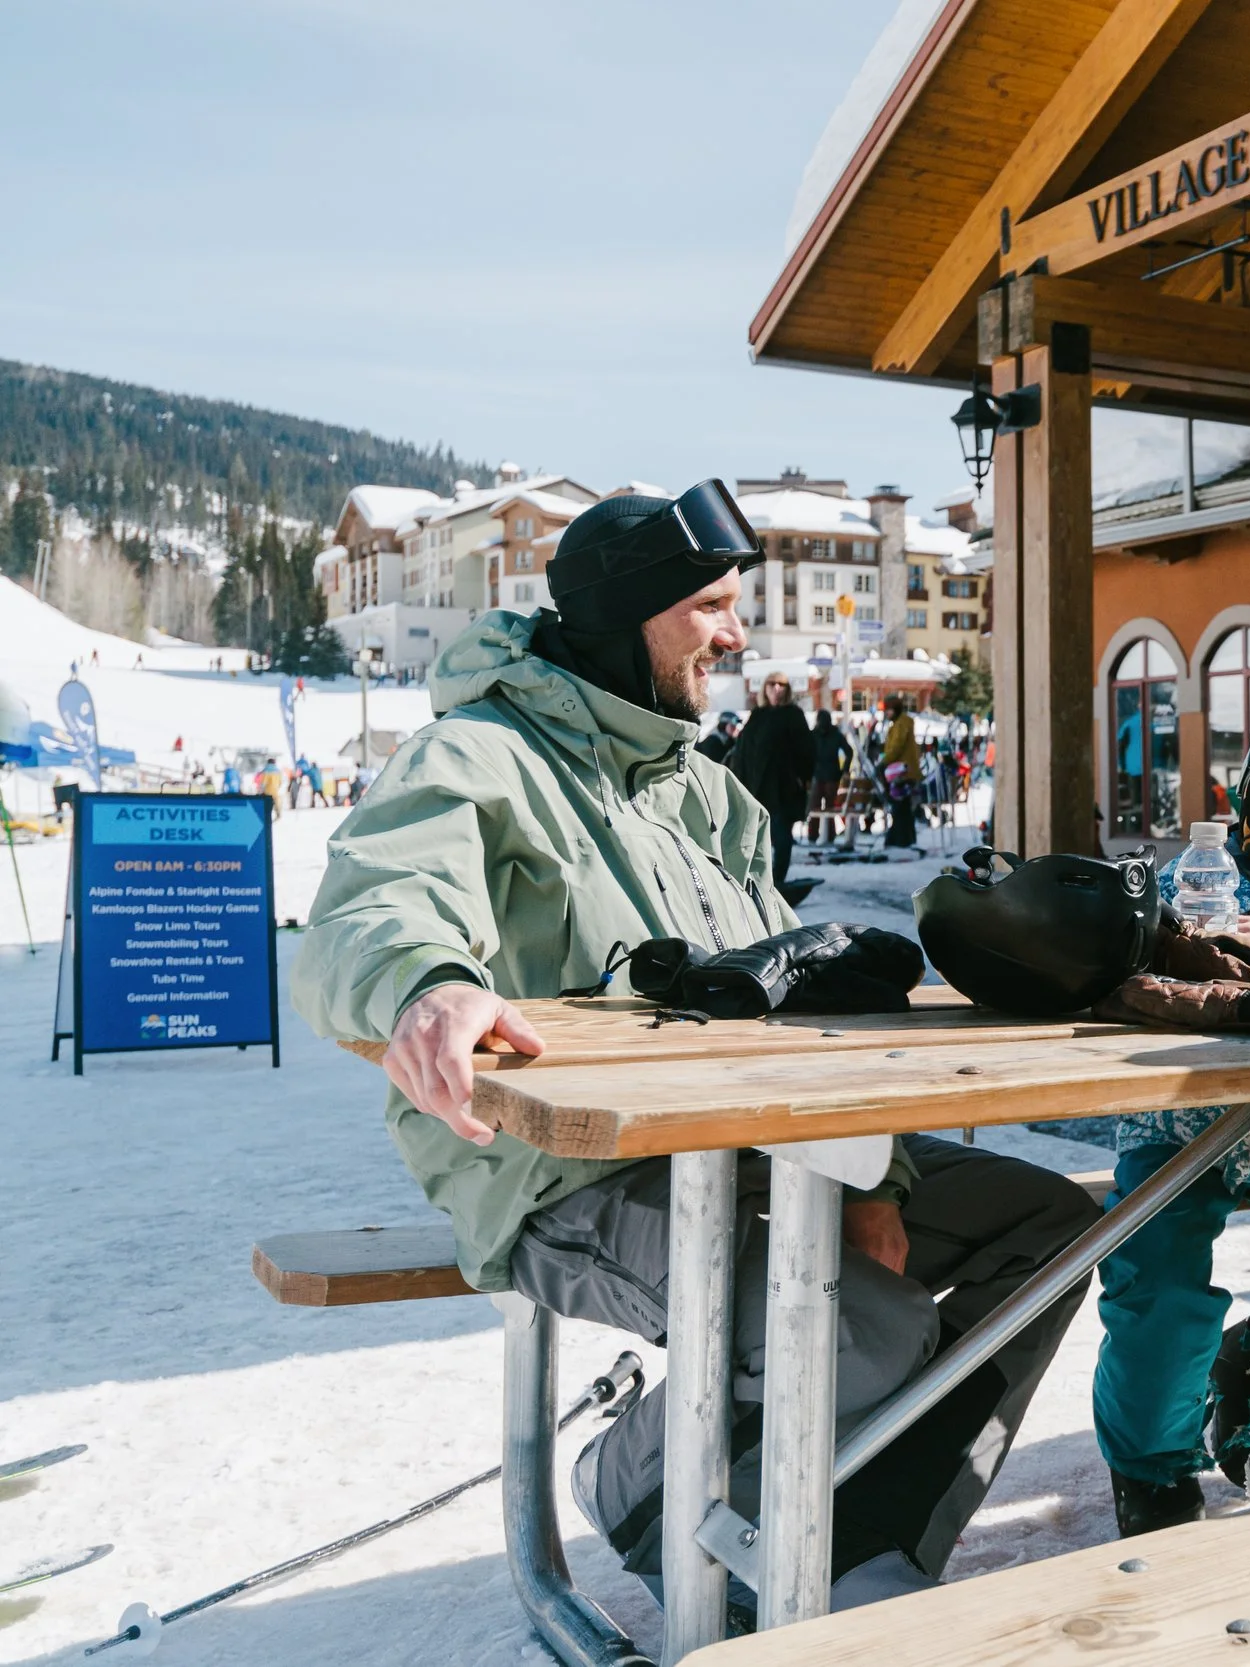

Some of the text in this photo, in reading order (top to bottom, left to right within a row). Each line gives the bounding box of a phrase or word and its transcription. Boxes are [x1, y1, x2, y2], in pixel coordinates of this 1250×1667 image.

[1087, 130, 1250, 244] VILLAGE
[116, 807, 230, 822] ACTIVITIES
[150, 828, 204, 841] DESK
[114, 861, 151, 872] OPEN
[155, 861, 184, 872] 8AM
[194, 861, 241, 872] 6:30PM
[89, 886, 261, 897] Alpine Fondue & Starlight Descent
[92, 903, 260, 915] Kamloops Blazers Hockey Games
[134, 921, 220, 931] Snow Limo Tours
[126, 938, 229, 950] Snowmobiling Tours
[110, 955, 244, 967] Snowshoe Rentals & Tours
[152, 973, 205, 984] Tube Time
[127, 991, 229, 1003] General Information
[168, 1014, 200, 1026] SUN
[167, 1025, 217, 1038] PEAKS
